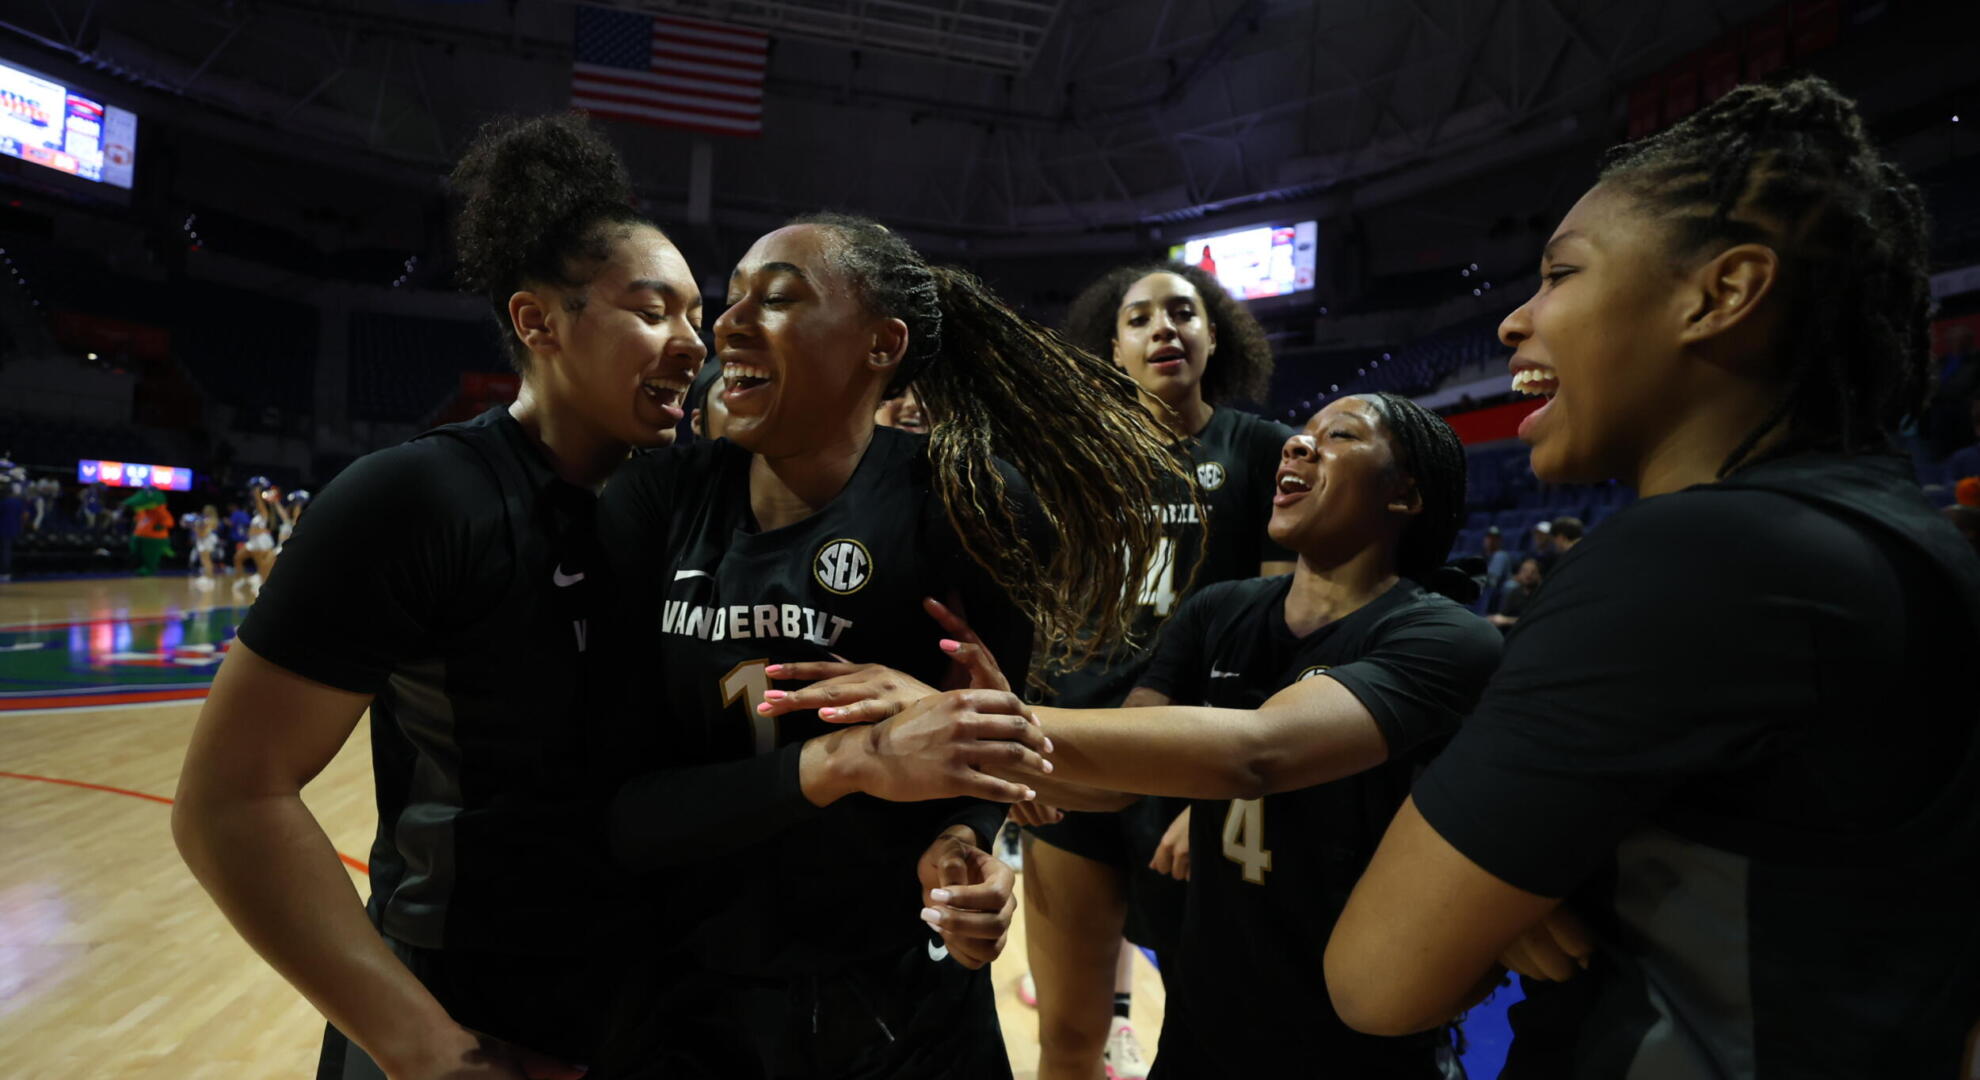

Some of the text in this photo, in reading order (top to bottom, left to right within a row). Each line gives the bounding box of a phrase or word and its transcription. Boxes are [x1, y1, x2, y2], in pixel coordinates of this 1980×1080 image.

[818, 542, 868, 591] SEC
[661, 600, 853, 647] VANDERBILT
[719, 658, 778, 757] 1
[1222, 797, 1273, 886] 4
